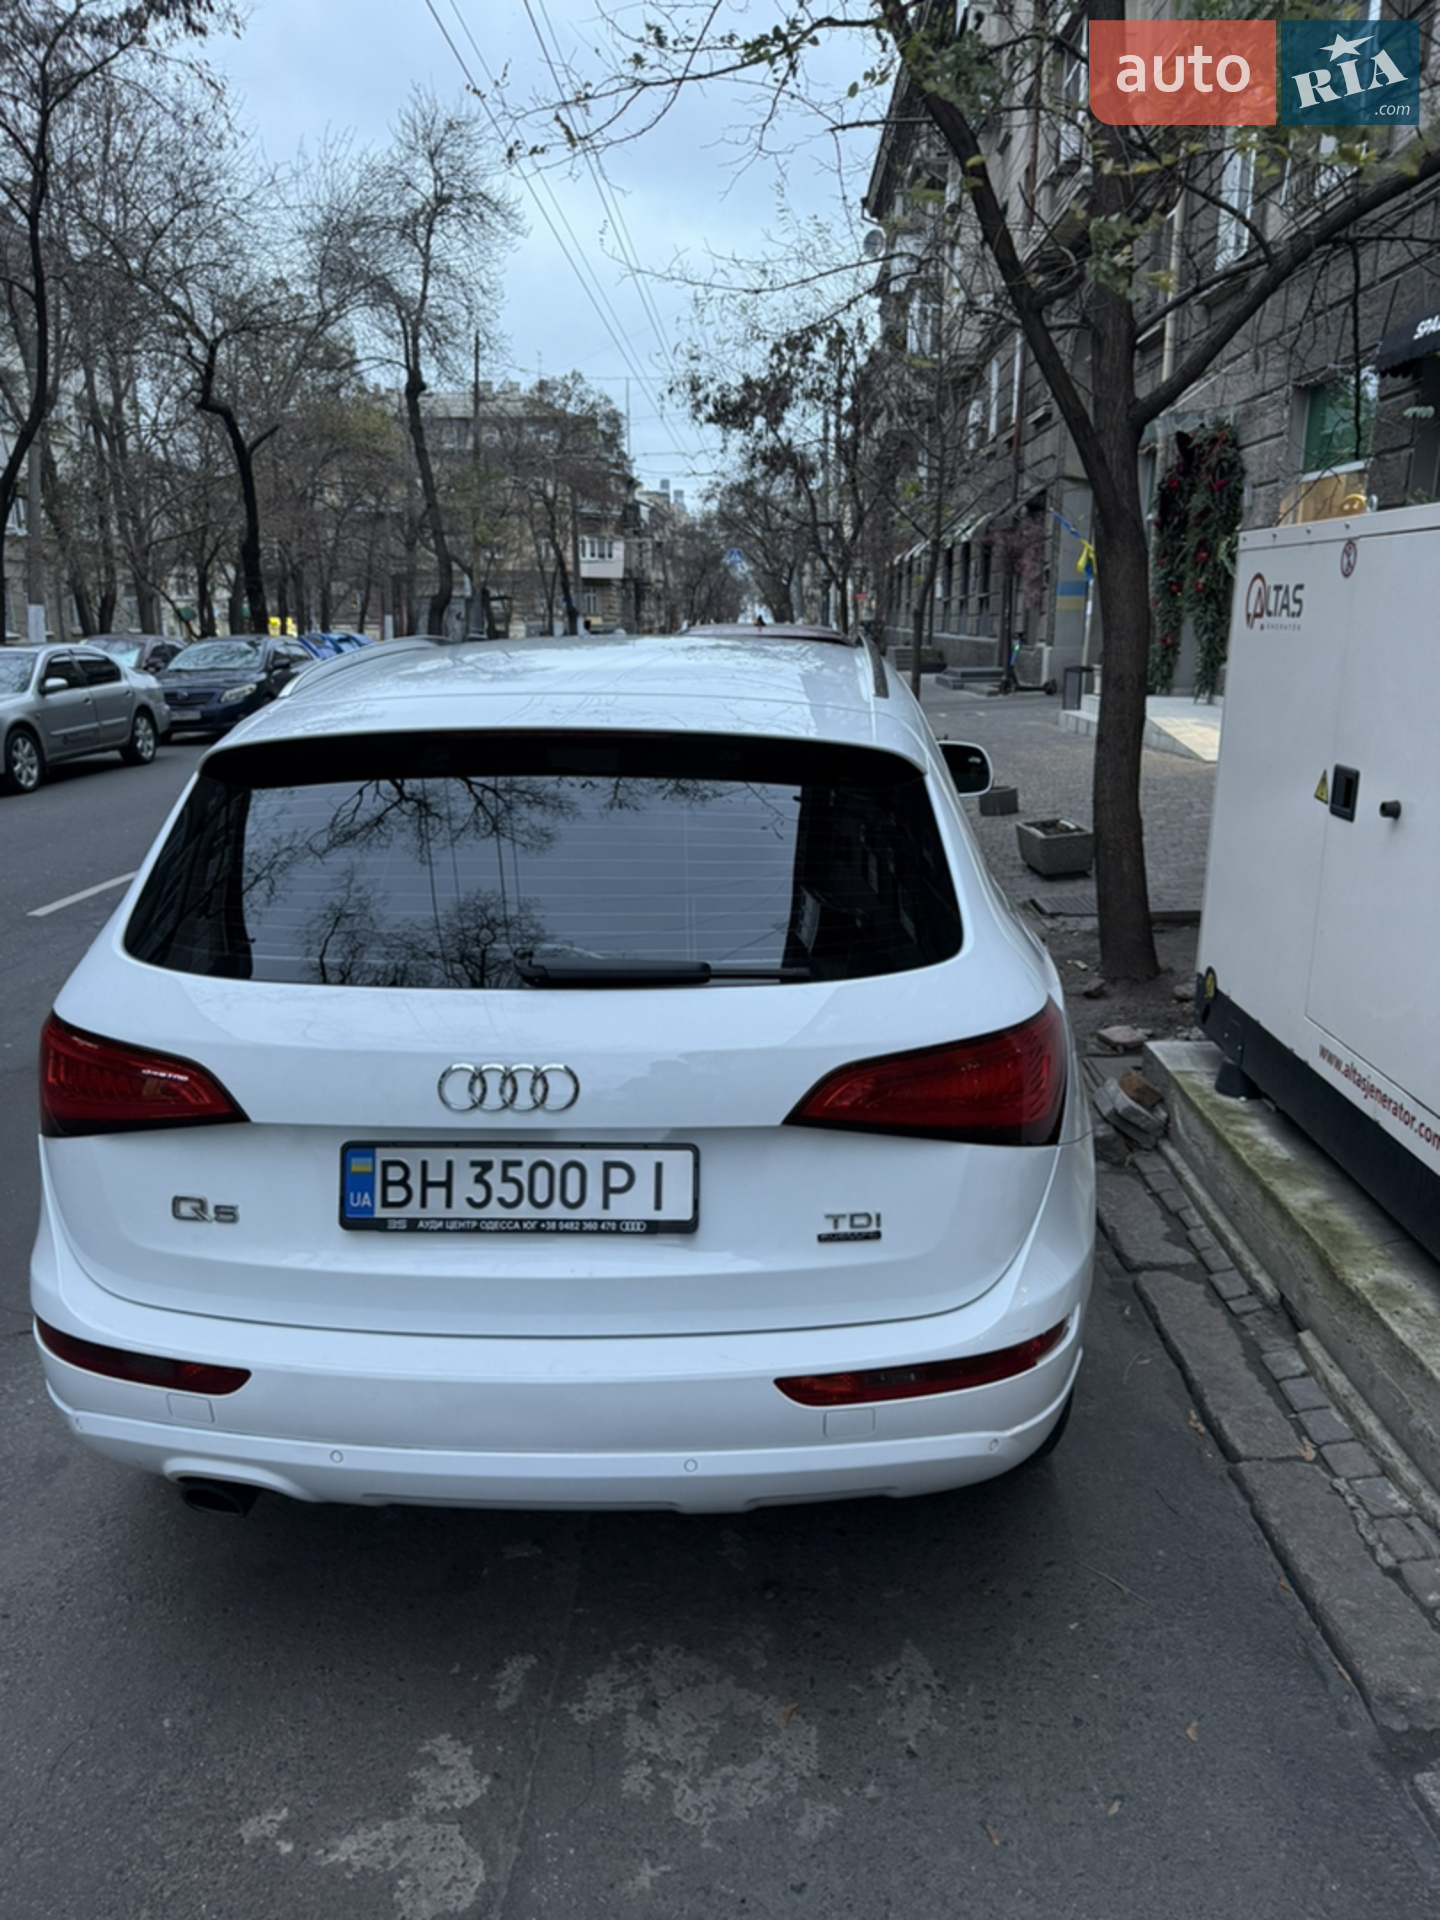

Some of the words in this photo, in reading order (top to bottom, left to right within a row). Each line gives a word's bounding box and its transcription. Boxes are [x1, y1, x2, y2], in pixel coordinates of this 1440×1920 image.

[381, 1160, 454, 1209] BH
[465, 1160, 588, 1210] 3500
[350, 1192, 372, 1208] UA
[172, 1196, 239, 1224] Q5
[417, 1221, 444, 1231] АУДИ
[446, 1221, 478, 1231] ЦЕНТР
[480, 1221, 520, 1231] ОДЕССА
[824, 1212, 882, 1230] TDI
